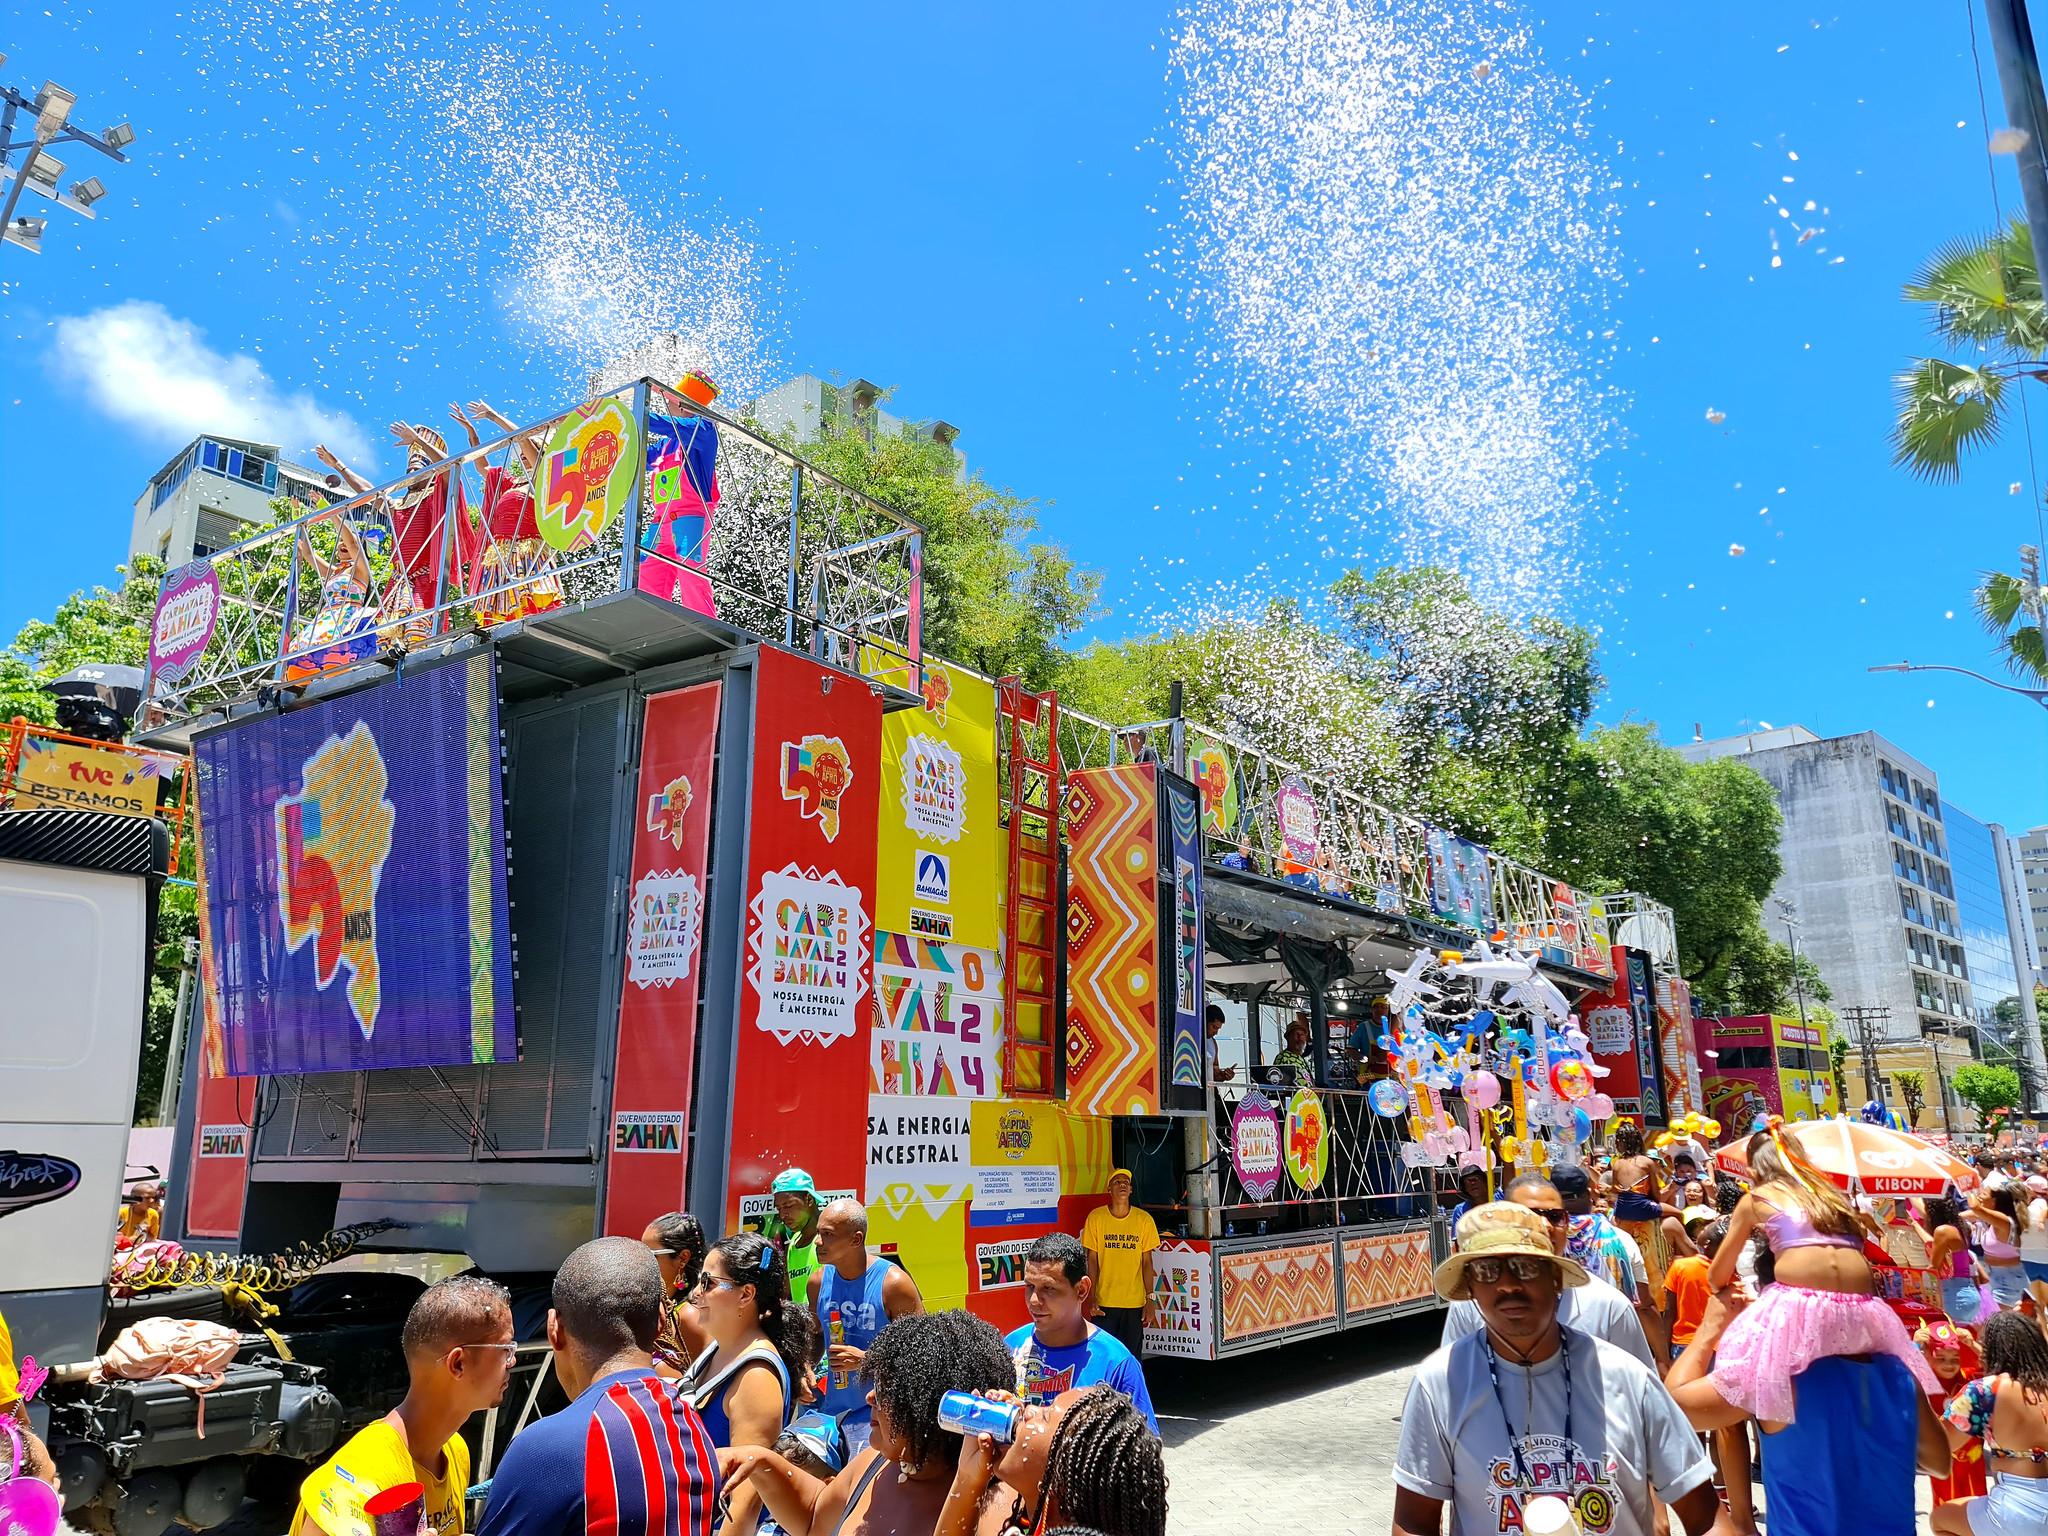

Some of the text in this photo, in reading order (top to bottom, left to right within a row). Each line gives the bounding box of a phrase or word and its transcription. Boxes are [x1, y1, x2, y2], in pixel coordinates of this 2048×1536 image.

[589, 453, 609, 471] AFRO
[586, 485, 606, 503] ANOS
[163, 594, 204, 622] CARNAVAL
[160, 610, 201, 642] BAHIA
[68, 761, 114, 787] tve
[822, 772, 838, 785] AFRO
[31, 784, 143, 812] ESTAMOS
[820, 797, 837, 810] ANOS
[914, 806, 931, 816] NOSSA
[912, 909, 931, 918] GOVERNO
[938, 914, 952, 922] ESTADO
[911, 914, 952, 937] BAHIA
[1177, 915, 1184, 936] DO
[638, 952, 683, 961] NOSSA ENERGIA
[647, 960, 676, 968] ANCESTRAL
[1177, 942, 1185, 1008] GOVERNO
[772, 990, 846, 1006] NOSSA ENERGIA
[779, 1002, 838, 1017] É ANCESTRAL
[1783, 1028, 1819, 1042] POSTO SLTUR
[618, 1114, 682, 1123] GOVERNO DO ESTADO
[897, 1116, 970, 1136] ENERGIA
[999, 1117, 1031, 1130] CAPITAL
[202, 1135, 244, 1154] BAHIA
[616, 1124, 679, 1150] BAHIA
[998, 1130, 1032, 1150] AFRO
[866, 1144, 959, 1166] NCESTRAL
[1876, 1178, 1924, 1191] KIBON
[743, 1199, 777, 1214] GOVE
[978, 1243, 1010, 1256] GOVERNO
[1011, 1242, 1021, 1254] DO
[1122, 1242, 1136, 1250] ALAS
[1168, 1336, 1202, 1344] ENERGIA
[1146, 1342, 1196, 1354] É ANCESTRAL
[1519, 1438, 1566, 1452] SVADOR
